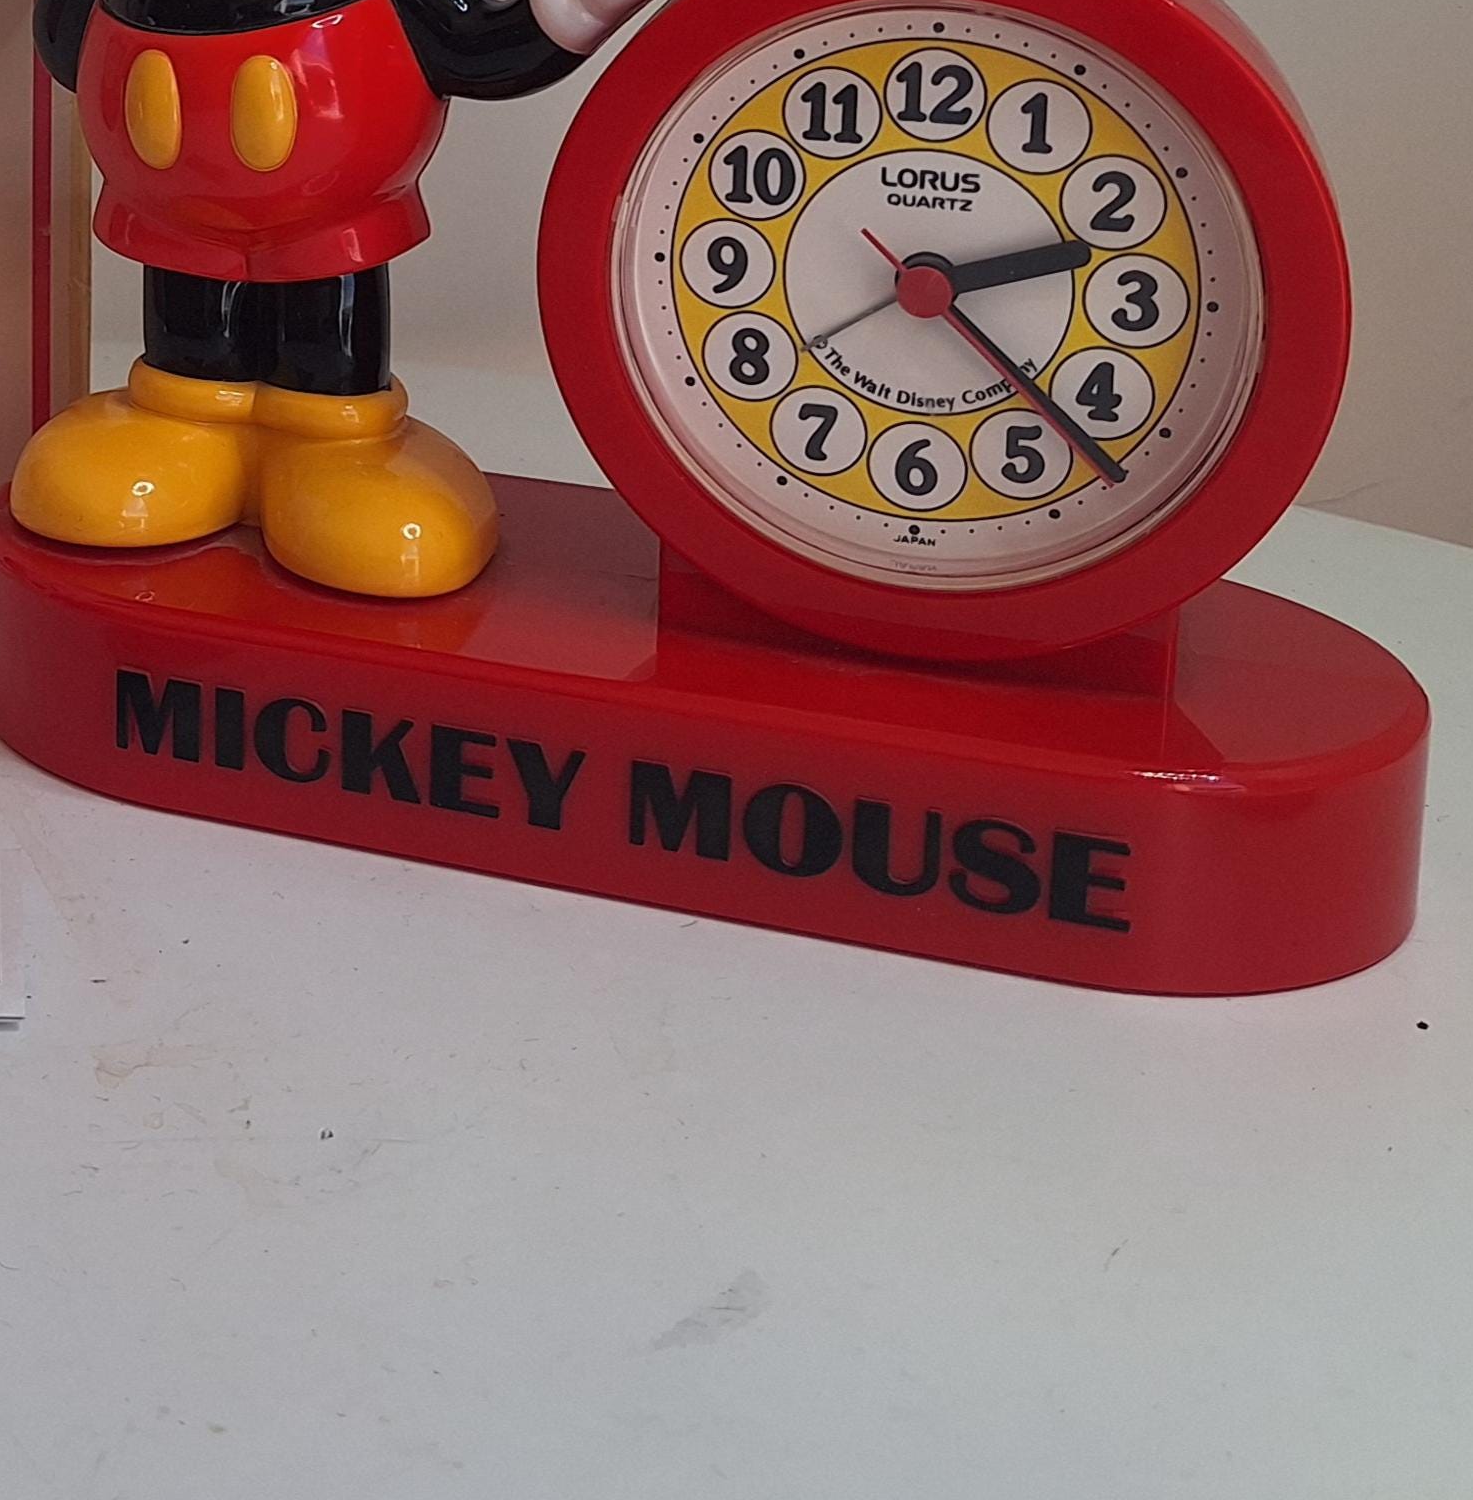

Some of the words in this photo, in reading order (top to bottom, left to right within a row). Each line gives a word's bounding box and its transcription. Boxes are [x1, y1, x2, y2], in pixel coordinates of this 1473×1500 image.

[800, 82, 863, 144] 11
[895, 62, 973, 125] 12
[1020, 92, 1050, 154] 1
[723, 145, 795, 206] 10
[880, 166, 981, 195] LORUS
[886, 193, 973, 212] QUARTZ
[1090, 171, 1136, 233] 2
[706, 236, 748, 293] 9
[1111, 270, 1159, 331] 3
[729, 328, 770, 385] 8
[825, 347, 850, 376] The
[853, 370, 891, 400] Walt
[896, 390, 955, 411] Disney
[1075, 362, 1123, 422] 4
[798, 403, 838, 461] 7
[1001, 425, 1045, 484] 5
[895, 439, 938, 496] 6
[893, 535, 936, 547] JAPAN
[115, 668, 588, 832] MICKEY
[628, 757, 1133, 934] MOUSE
